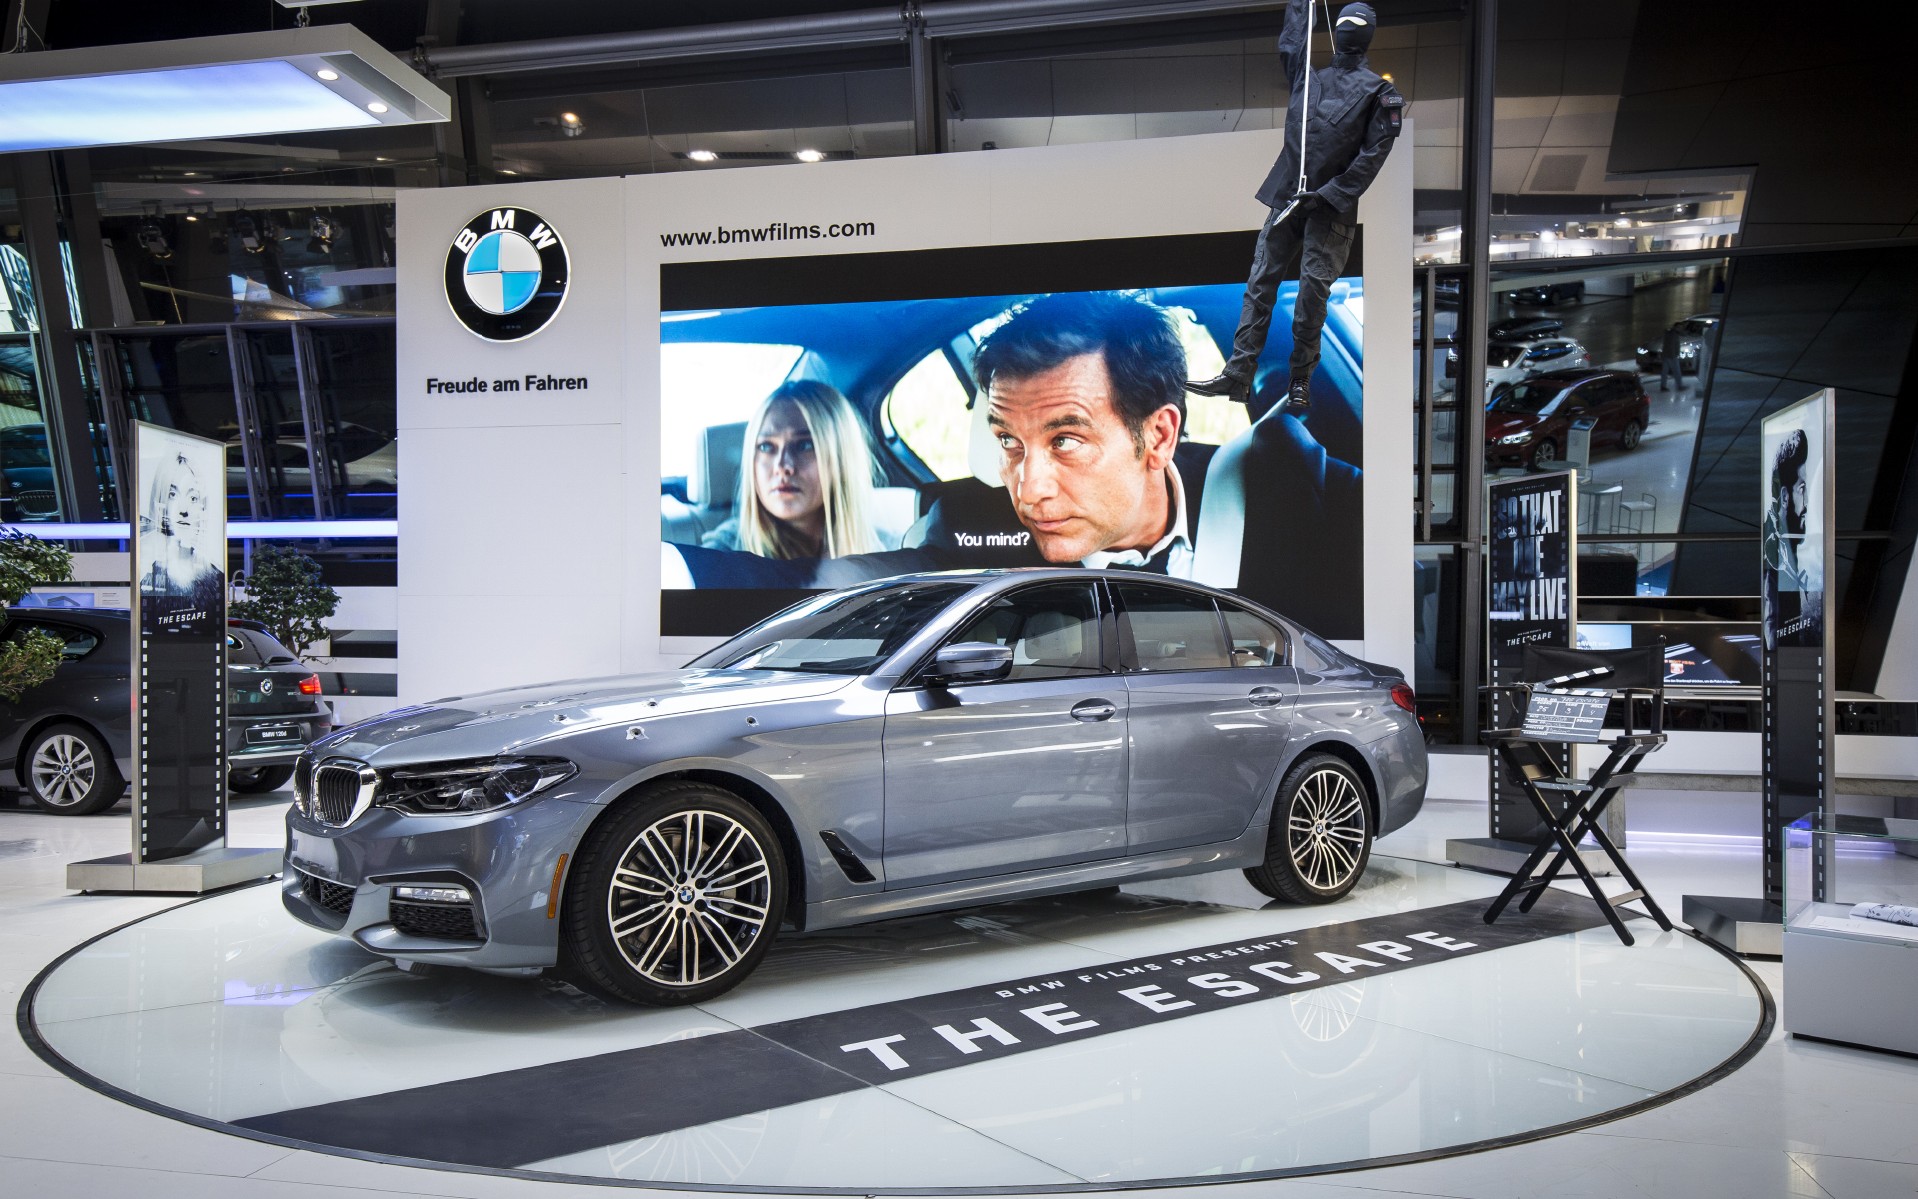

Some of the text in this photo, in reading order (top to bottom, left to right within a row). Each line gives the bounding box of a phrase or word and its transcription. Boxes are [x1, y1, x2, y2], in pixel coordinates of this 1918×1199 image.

[454, 209, 557, 254] BMW
[660, 221, 875, 247] www.bmwfilms.com
[426, 374, 588, 394] Freude am Fahren
[1519, 490, 1561, 536] THAT
[954, 531, 1031, 546] You mind?
[1493, 577, 1567, 621] MAY LIVE
[158, 611, 207, 625] THE ESCAPE
[1776, 627, 1787, 639] THE
[1788, 617, 1811, 634] ESCAPE
[1507, 637, 1520, 647] THE
[1522, 631, 1552, 643] ECAPE
[995, 939, 1299, 999] BMW FILMS PRESENTS
[839, 930, 1479, 1071] THE ESCAPE
